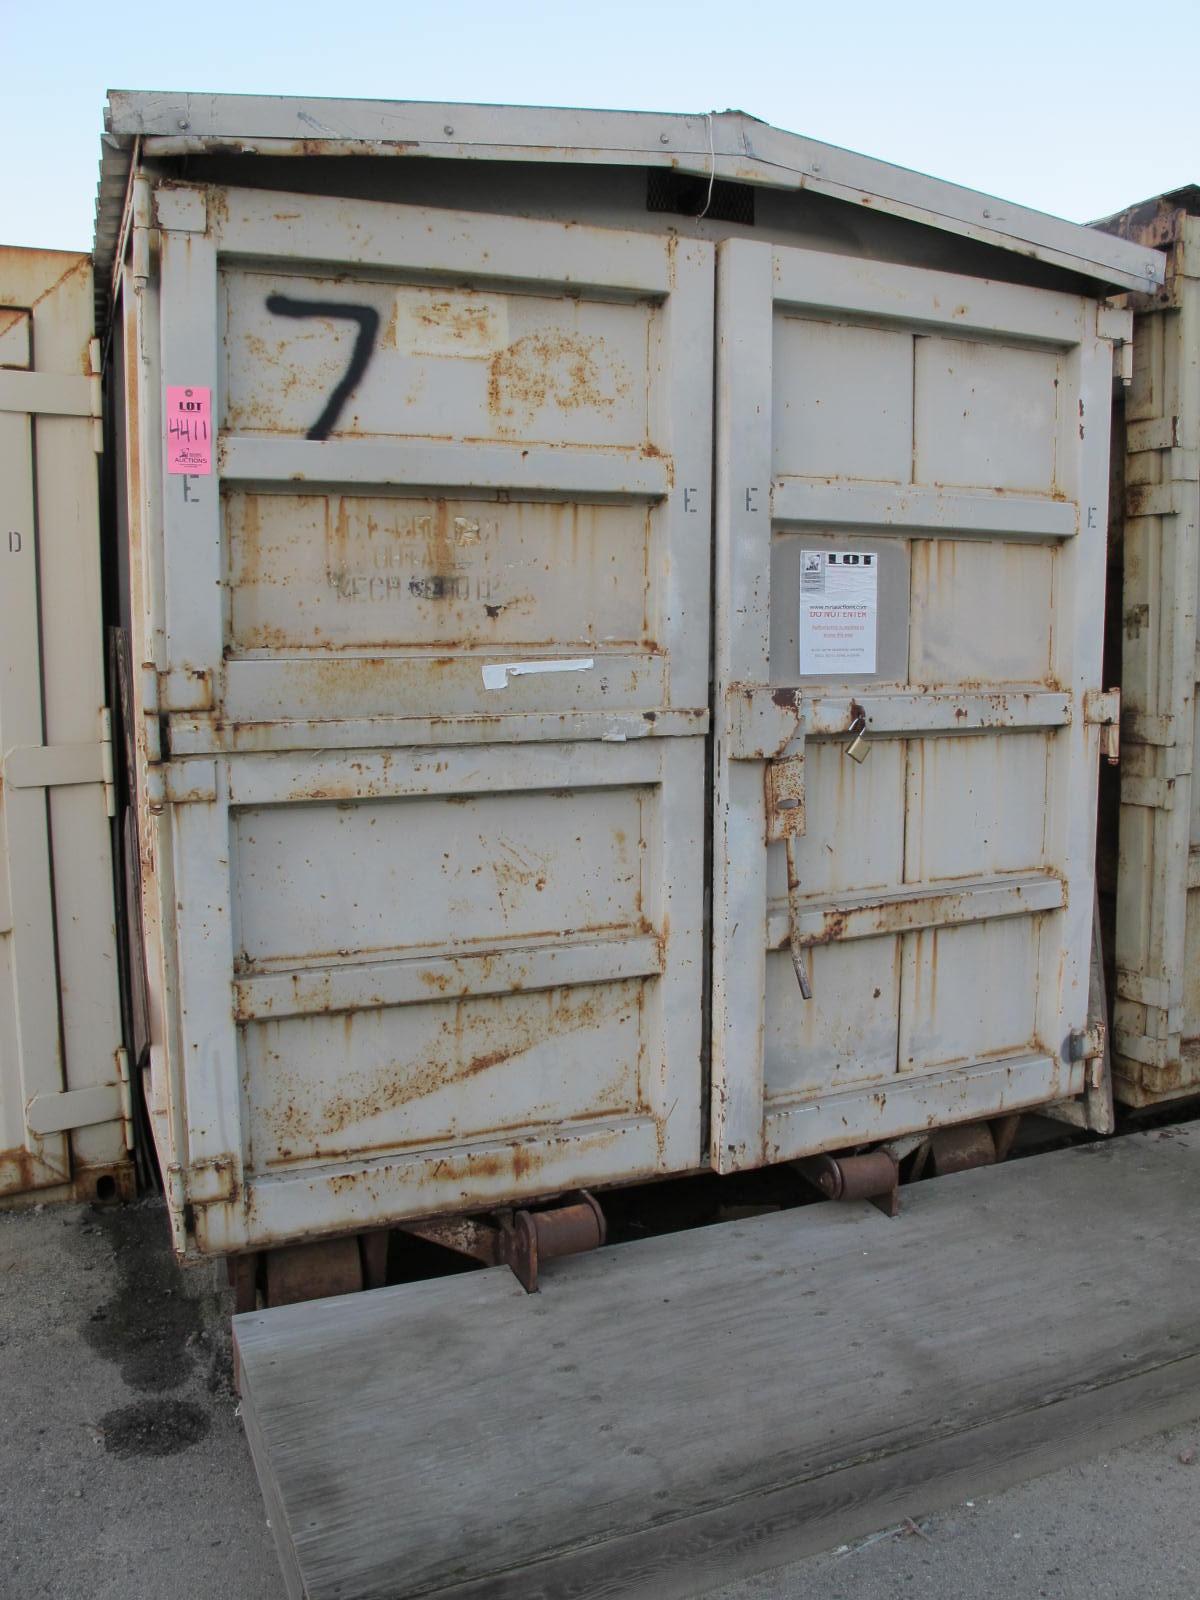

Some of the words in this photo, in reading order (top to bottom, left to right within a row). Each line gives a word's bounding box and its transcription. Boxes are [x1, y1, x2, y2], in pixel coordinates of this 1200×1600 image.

[266, 293, 379, 440] 7
[179, 402, 202, 411] LOT
[169, 418, 207, 442] 4411
[684, 488, 697, 512] E
[746, 487, 758, 512] E
[1087, 506, 1097, 528] E
[9, 531, 21, 552] D
[827, 553, 874, 566] LOT
